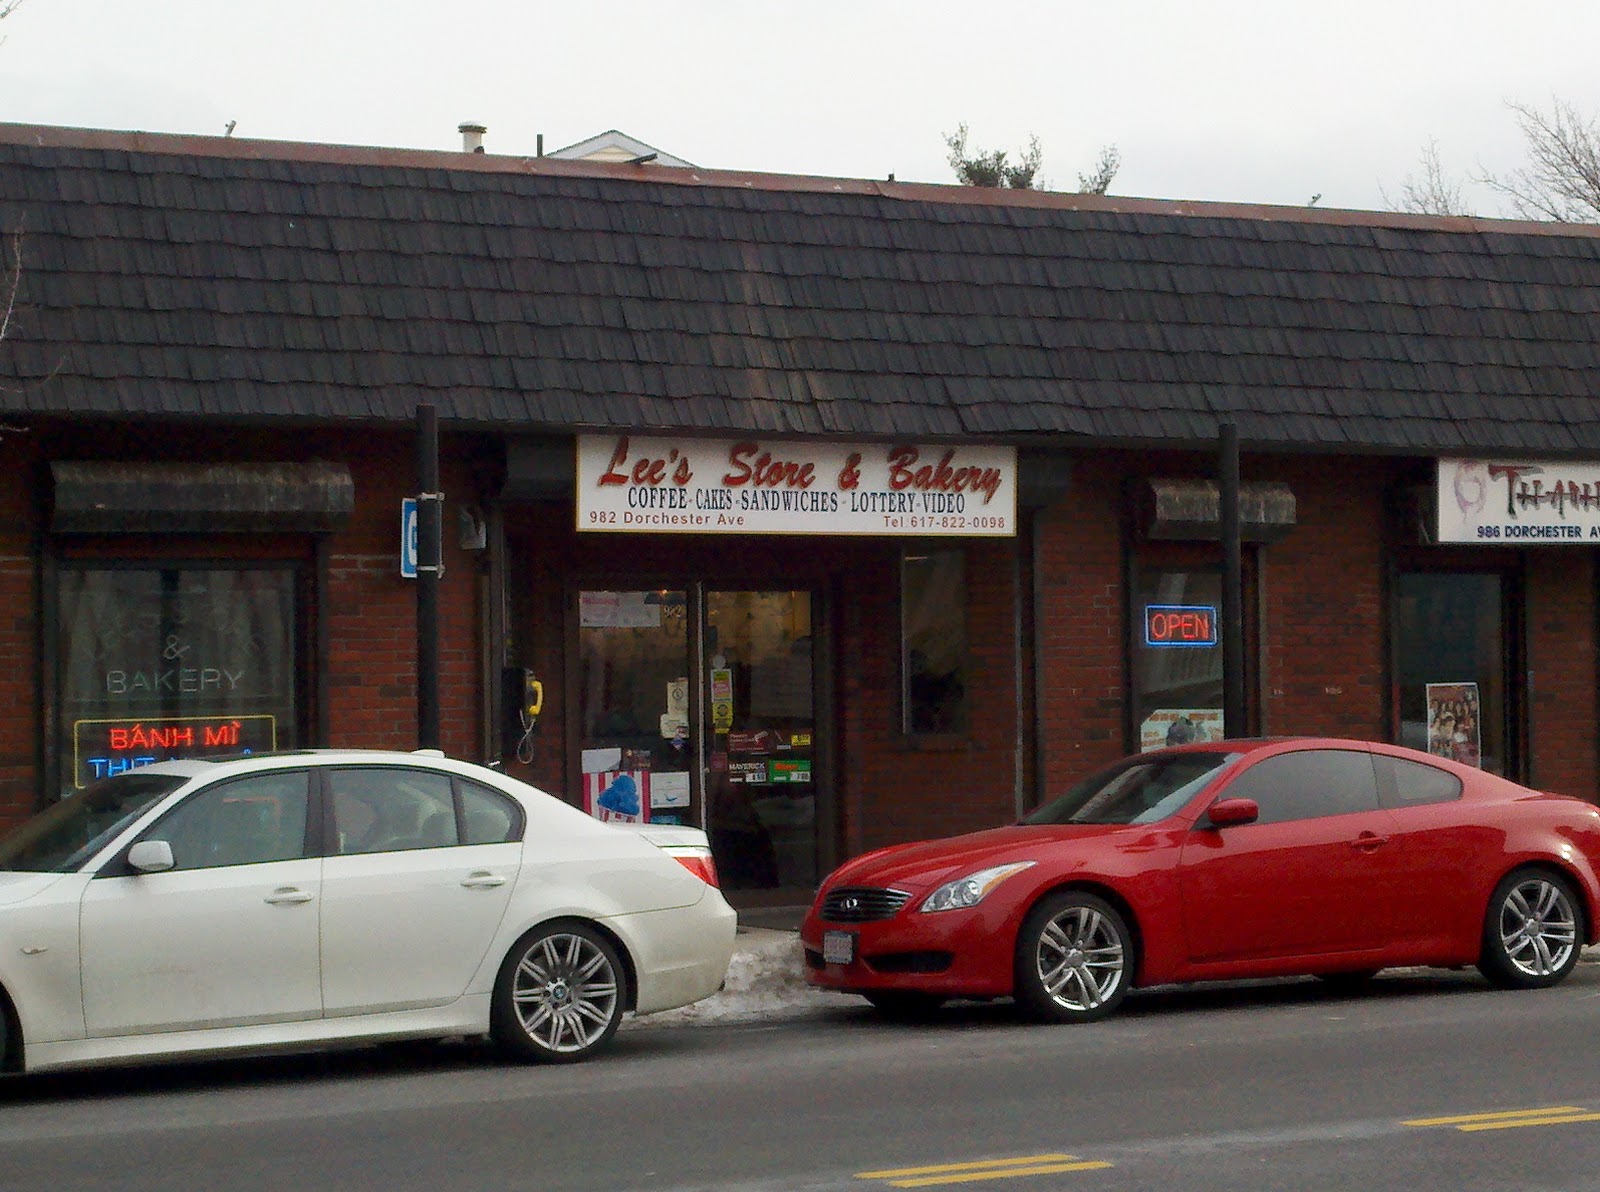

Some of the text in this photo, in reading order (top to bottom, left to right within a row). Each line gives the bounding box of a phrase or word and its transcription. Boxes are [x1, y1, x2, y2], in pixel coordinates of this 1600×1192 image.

[598, 435, 1002, 505] Lee's Store & Bakery
[628, 487, 966, 514] COFFEE CAKES SANDWICHES LOTTERY VIDEO
[589, 511, 745, 526] 982 Dorchester Ave
[910, 516, 1006, 529] 617-822-0098
[1477, 525, 1500, 538] 986
[1505, 525, 1582, 538] DORCHESTER
[1151, 613, 1209, 639] OPEN
[163, 634, 190, 660] &
[106, 668, 245, 694] BAKERY
[110, 723, 193, 750] BÁNH
